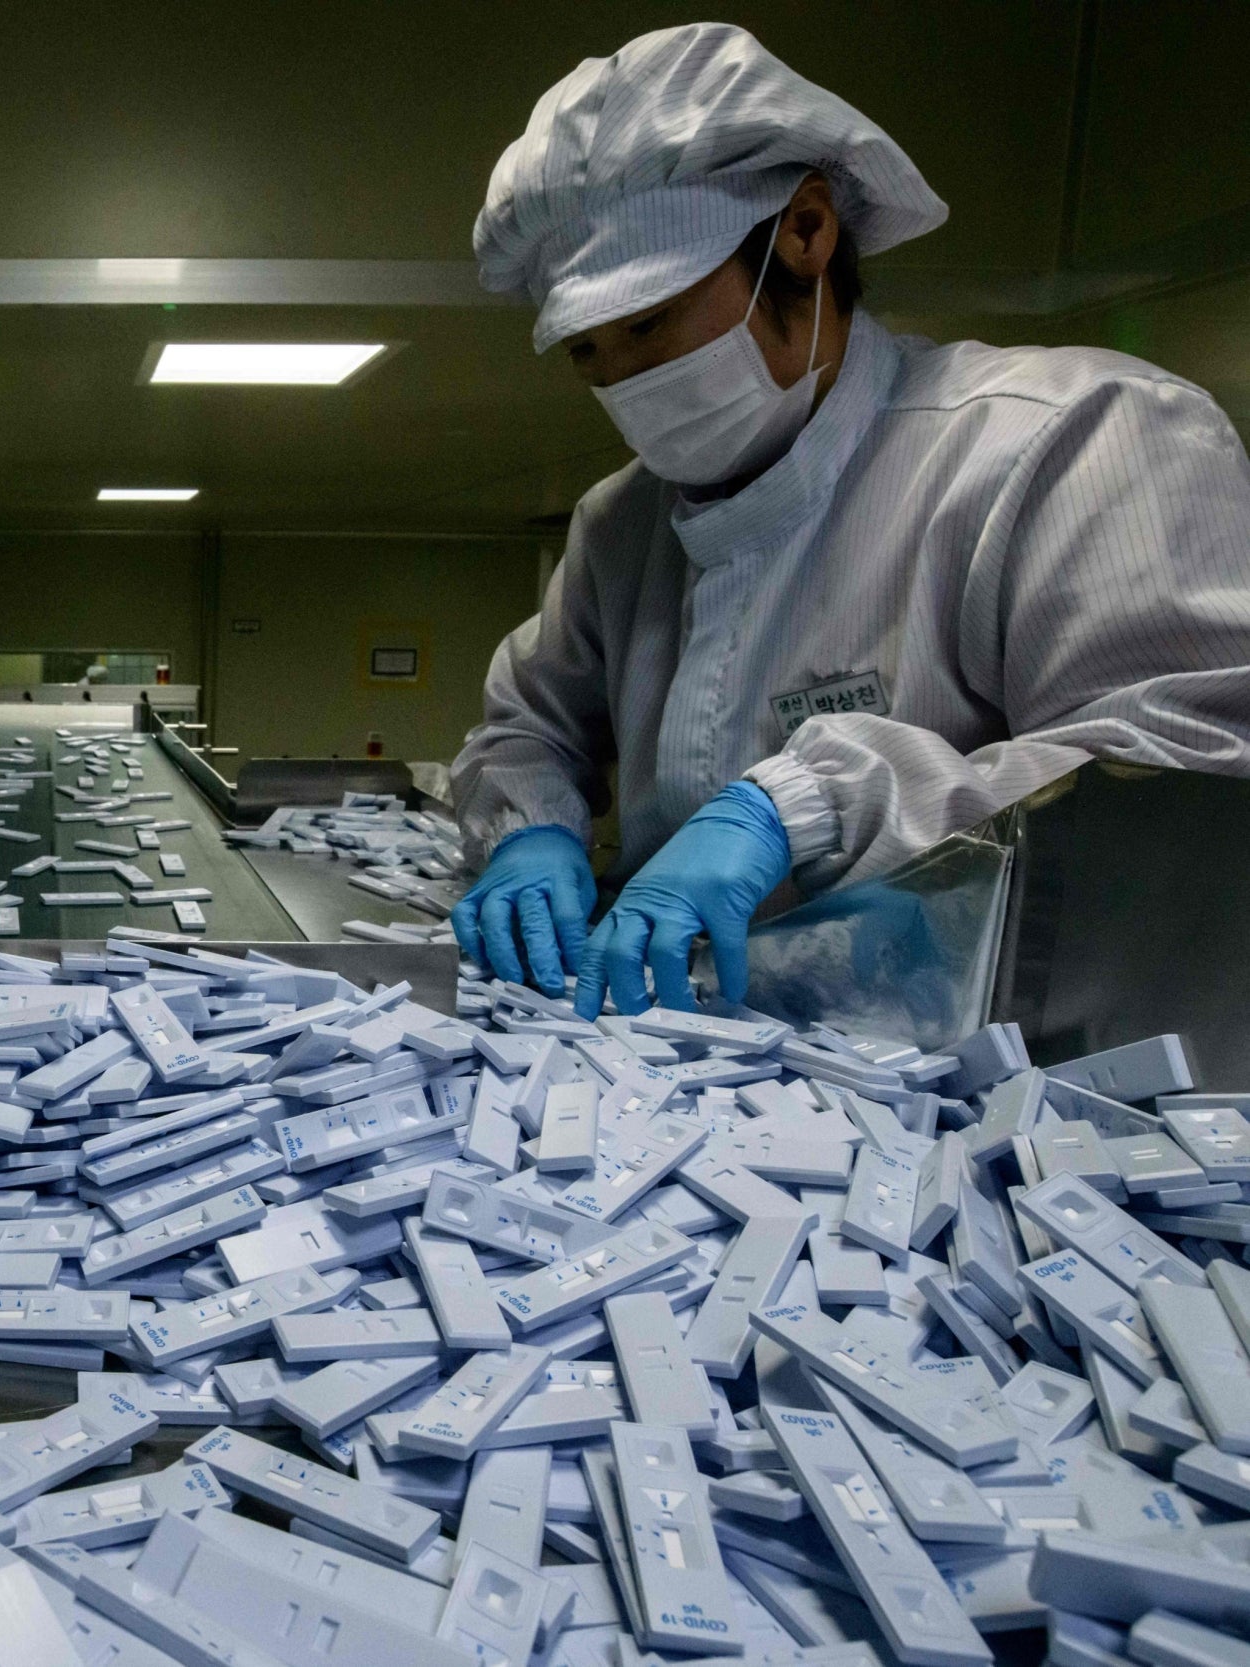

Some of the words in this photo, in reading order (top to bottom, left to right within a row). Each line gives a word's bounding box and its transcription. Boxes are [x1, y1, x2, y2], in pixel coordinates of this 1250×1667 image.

[778, 696, 802, 713] 생산
[815, 684, 878, 713] 박상찬
[166, 1055, 201, 1070] COVID-19
[174, 1054, 187, 1062] IgG
[637, 1065, 674, 1081] COVID-19
[442, 1083, 456, 1115] OVID-19
[281, 1126, 298, 1159] OVID-19
[295, 1136, 304, 1150] IgG
[870, 1148, 912, 1172] COVID-19
[564, 1195, 603, 1213] COVID-19
[584, 1195, 597, 1203] IgG
[1034, 1256, 1078, 1278] COVID-19
[1060, 1271, 1076, 1283] IgG
[499, 1290, 531, 1314] COVID-19
[519, 1294, 531, 1303] IgG
[764, 1305, 808, 1319] COVID-19
[787, 1314, 803, 1322] IgG
[140, 1321, 166, 1348] COVID-19
[158, 1326, 170, 1337] IgG
[917, 1360, 974, 1371] COVID-19
[108, 1393, 147, 1419] COVID-19
[111, 1404, 126, 1415] IgG
[435, 1422, 452, 1430] IgG
[780, 1413, 835, 1430] COVID-19
[411, 1422, 463, 1439] COVID-19
[803, 1427, 823, 1437] IgG
[198, 1431, 231, 1454] COVID-19
[219, 1442, 231, 1452] IgG
[191, 1469, 218, 1499] COVID-19
[681, 1603, 703, 1615] IgG
[661, 1612, 729, 1633] COVID-19
